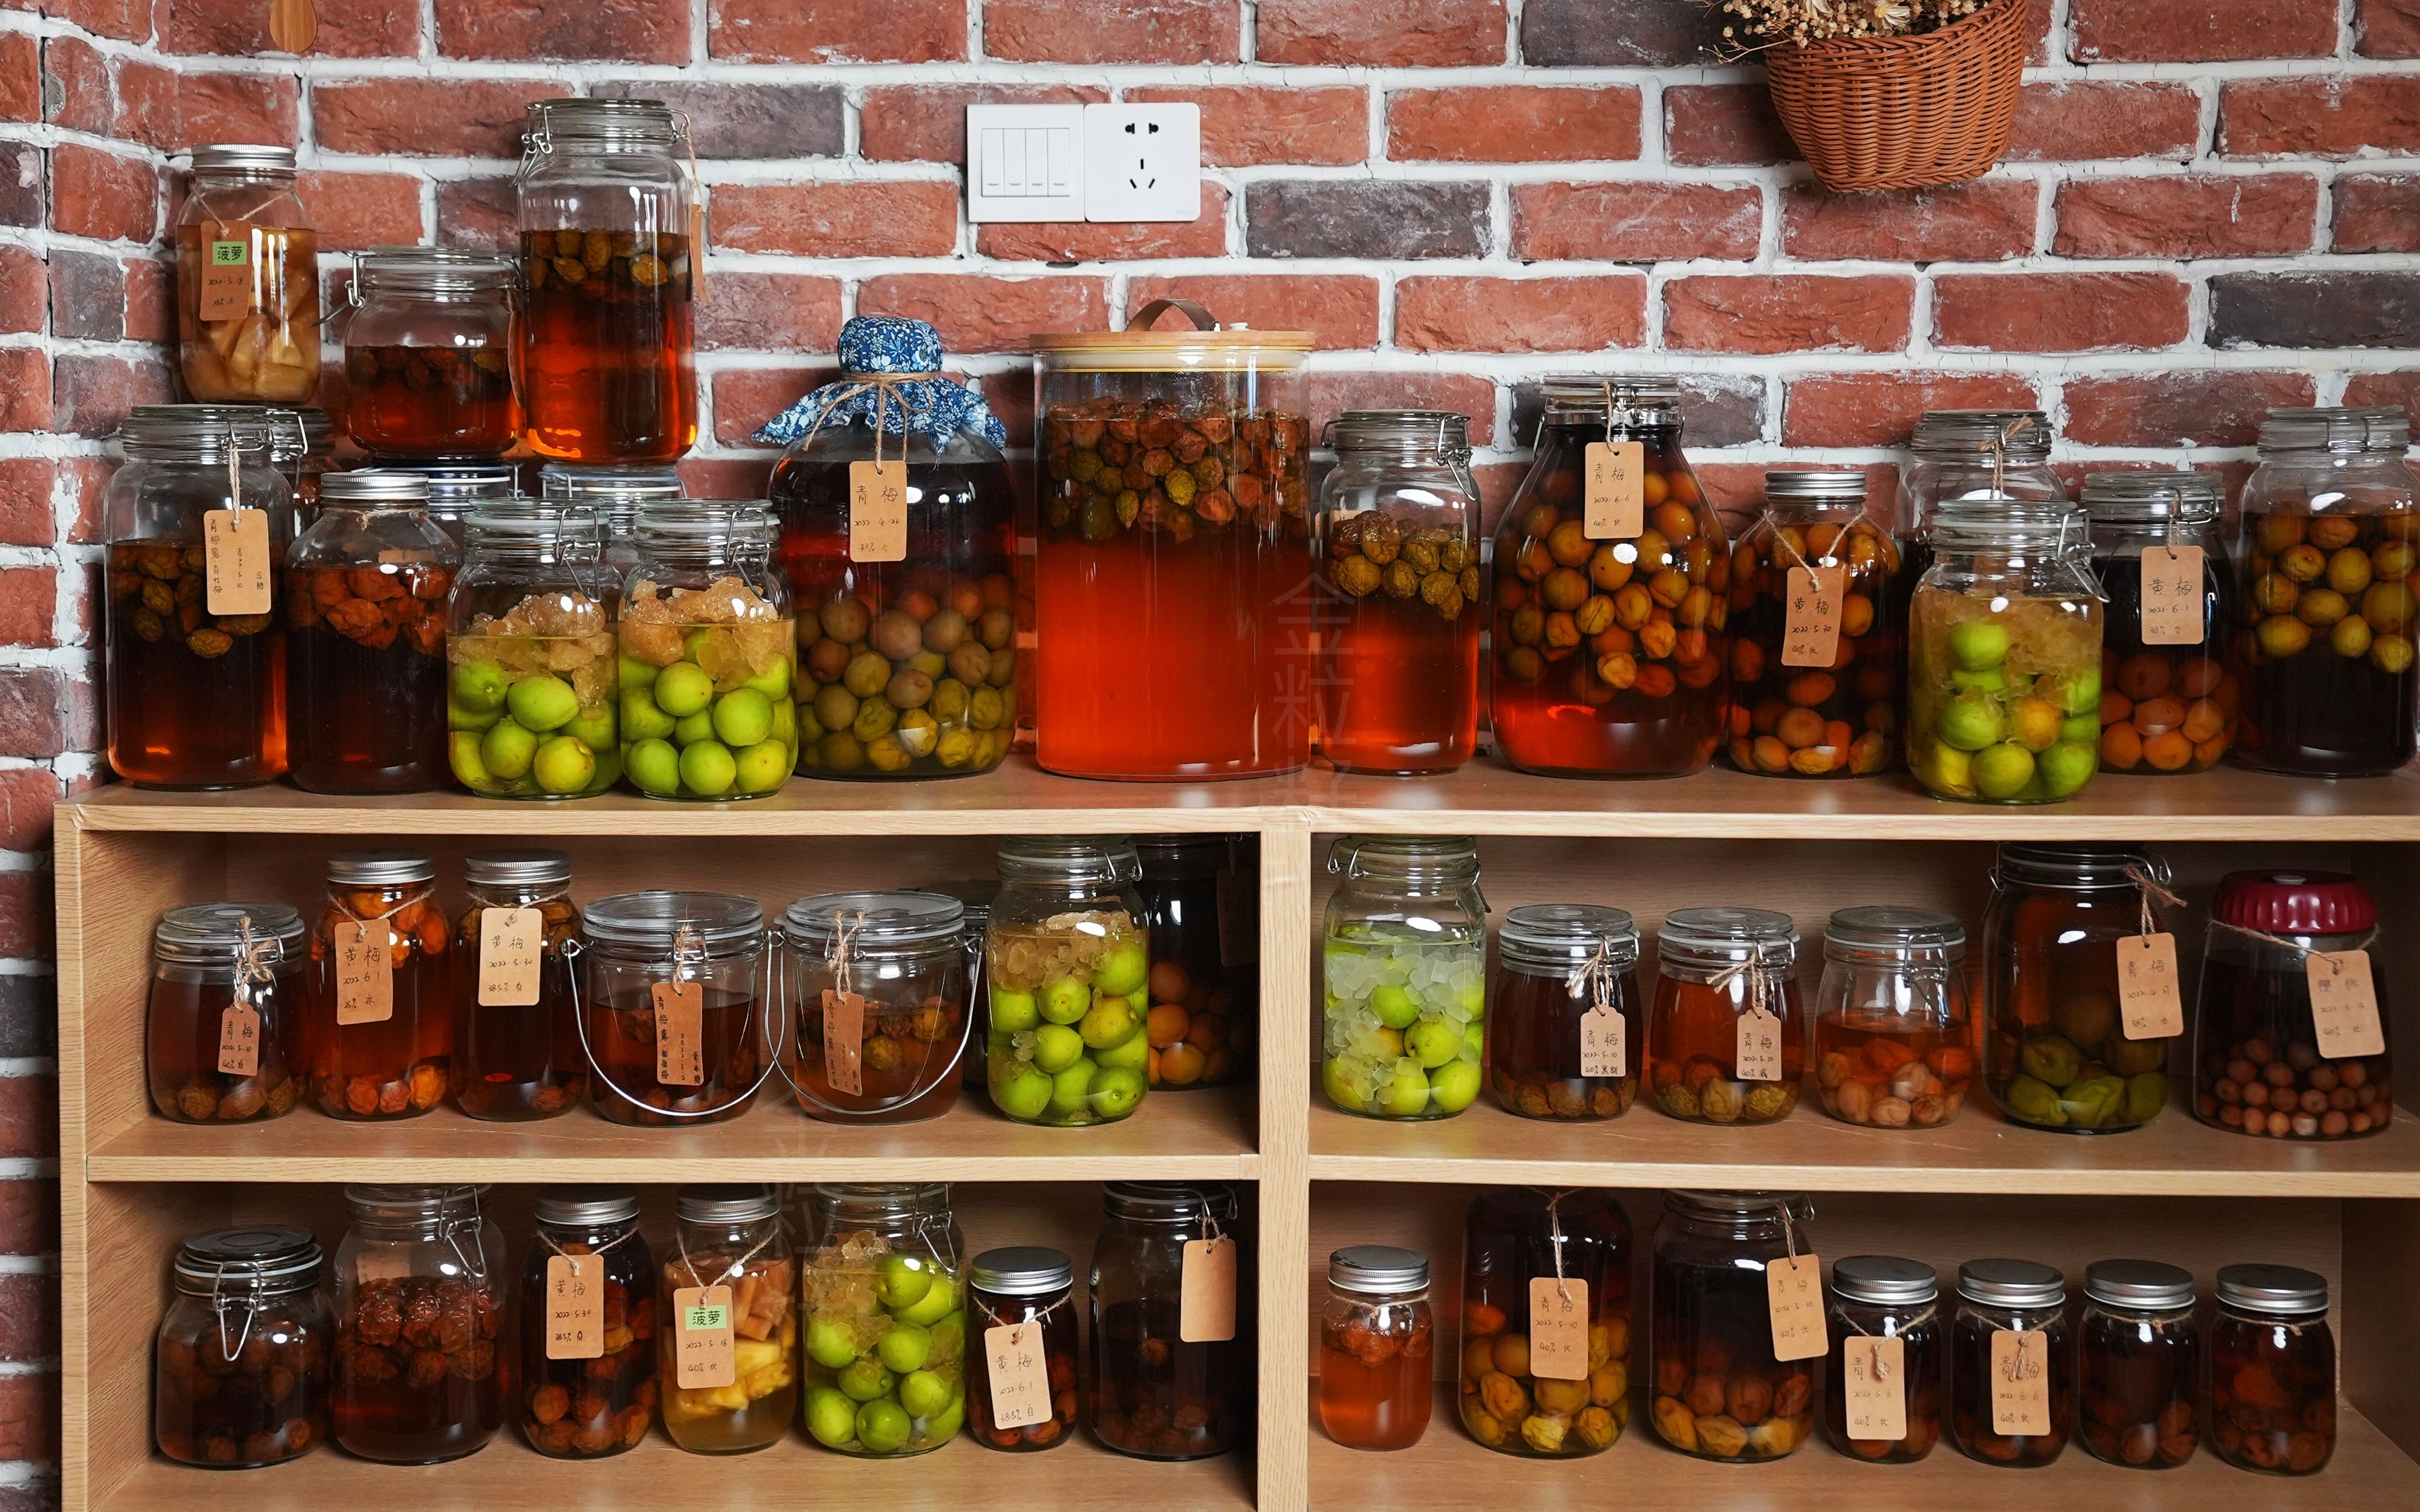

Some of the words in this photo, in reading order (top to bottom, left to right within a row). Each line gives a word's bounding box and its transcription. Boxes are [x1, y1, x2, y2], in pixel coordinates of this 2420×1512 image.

[217, 245, 242, 261] 菠萝
[1594, 463, 1624, 484] 青梅
[856, 485, 898, 505] 青梅
[2148, 575, 2192, 596] 黄梅
[1793, 597, 1829, 615] 黄梅
[491, 935, 523, 950] 黄梅
[344, 944, 380, 967] 黄梅
[227, 1020, 253, 1040] 青梅
[1586, 1030, 1619, 1047] 青梅
[1743, 1032, 1773, 1050] 青梅
[555, 1280, 586, 1298] 黄梅
[1541, 1296, 1573, 1312] 青梅
[692, 1310, 721, 1326] 菠萝
[995, 1351, 1032, 1374] 黄梅
